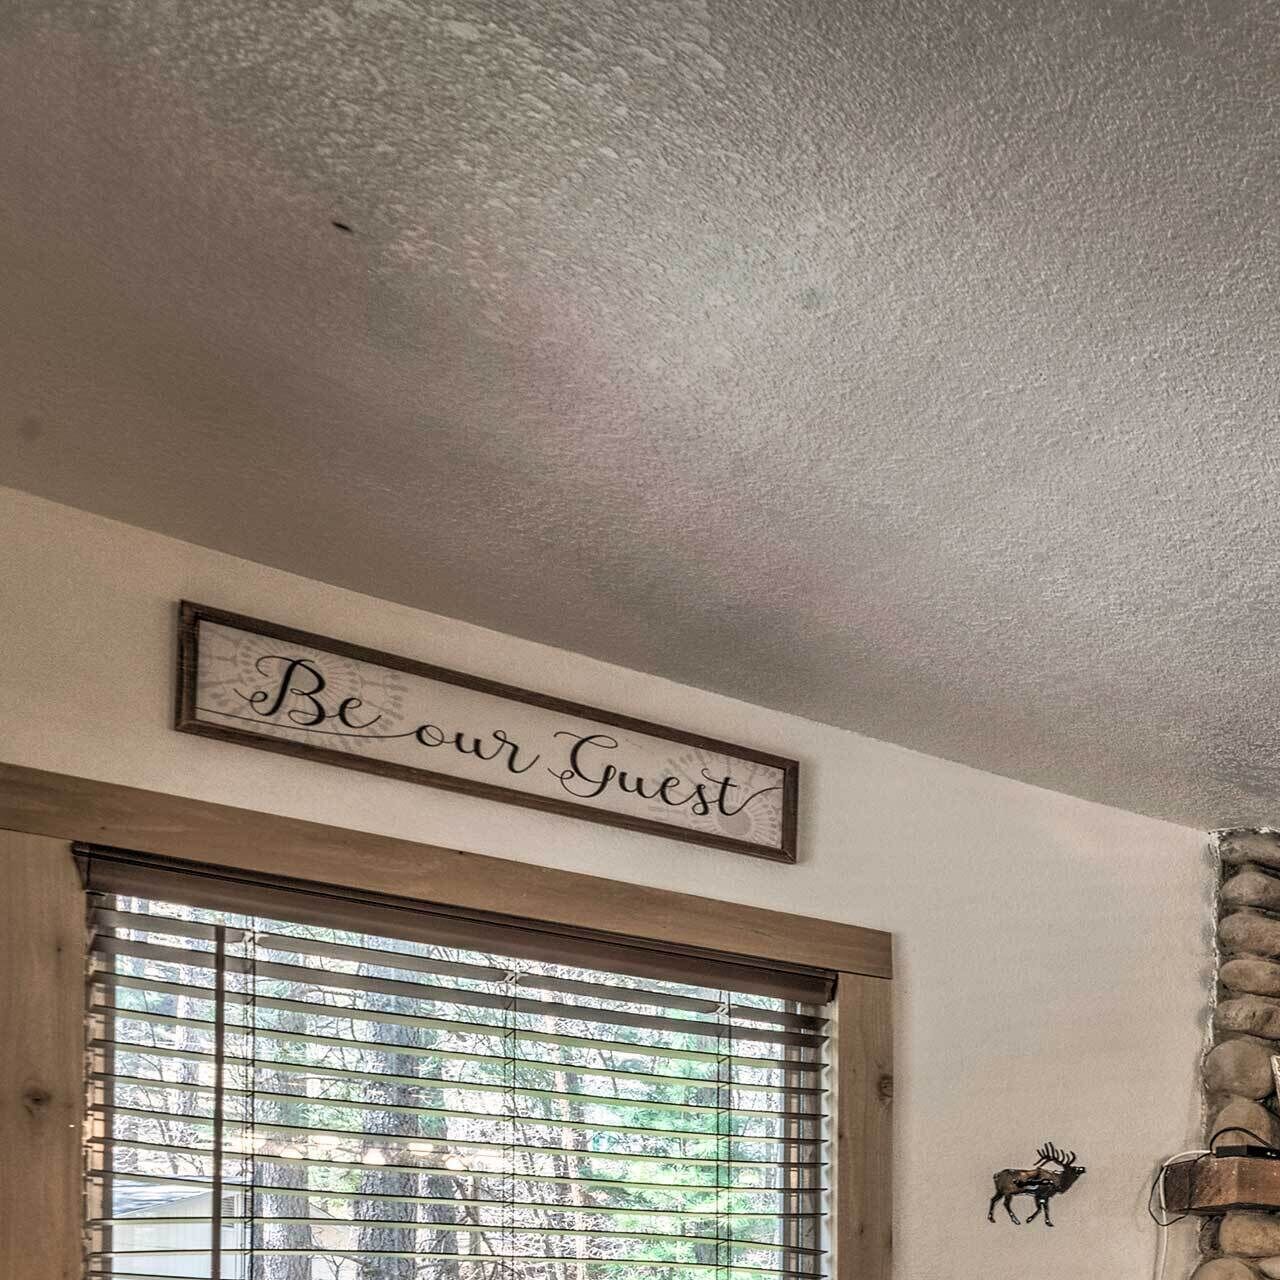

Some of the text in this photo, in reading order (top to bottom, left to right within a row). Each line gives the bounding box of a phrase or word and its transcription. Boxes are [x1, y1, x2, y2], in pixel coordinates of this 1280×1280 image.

[232, 654, 782, 817] Be our Guest
